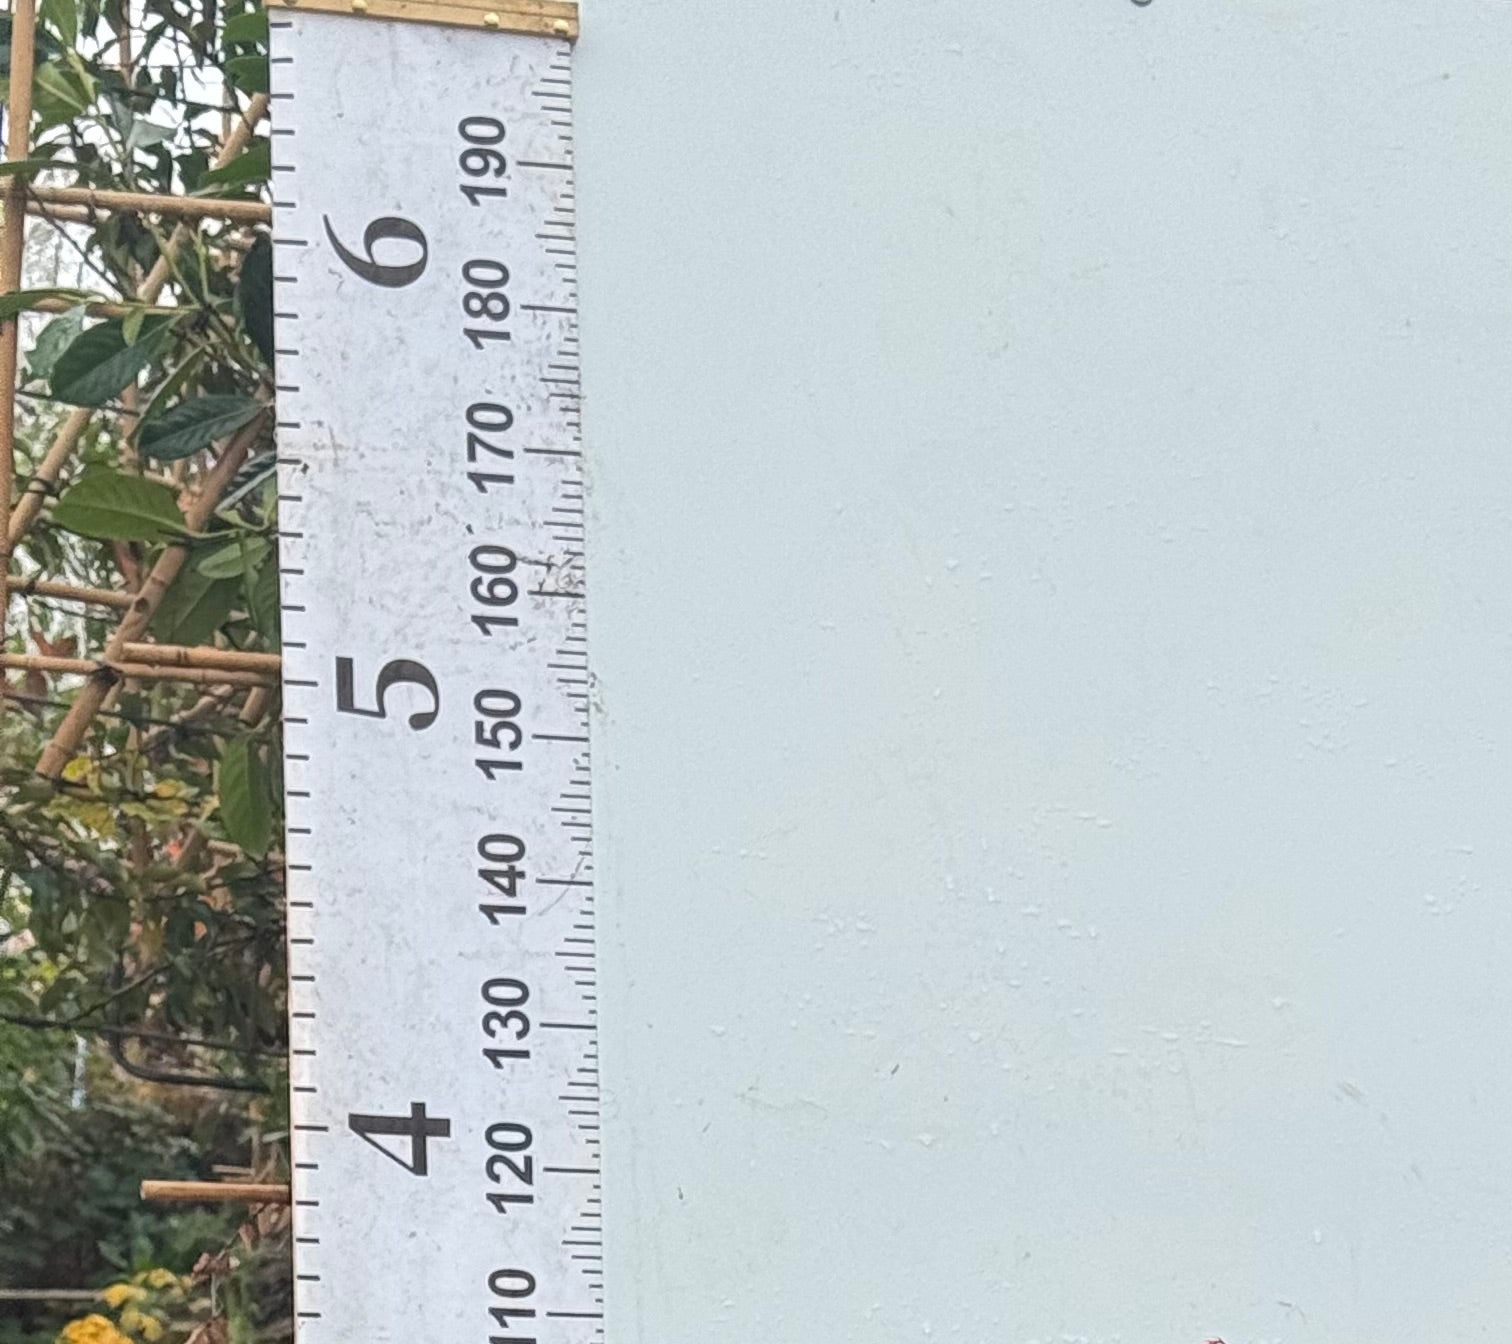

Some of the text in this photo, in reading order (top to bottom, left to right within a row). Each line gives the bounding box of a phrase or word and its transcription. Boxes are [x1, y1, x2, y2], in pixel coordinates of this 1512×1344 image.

[458, 116, 507, 206] 190
[323, 214, 428, 288] 6
[462, 259, 511, 350] 180
[465, 402, 515, 494] 170
[468, 545, 518, 636] 160
[335, 656, 440, 731] 5
[473, 689, 523, 780] 150
[477, 833, 527, 925] 140
[481, 977, 531, 1069] 130
[348, 1102, 451, 1177] 4
[484, 1122, 534, 1214] 120
